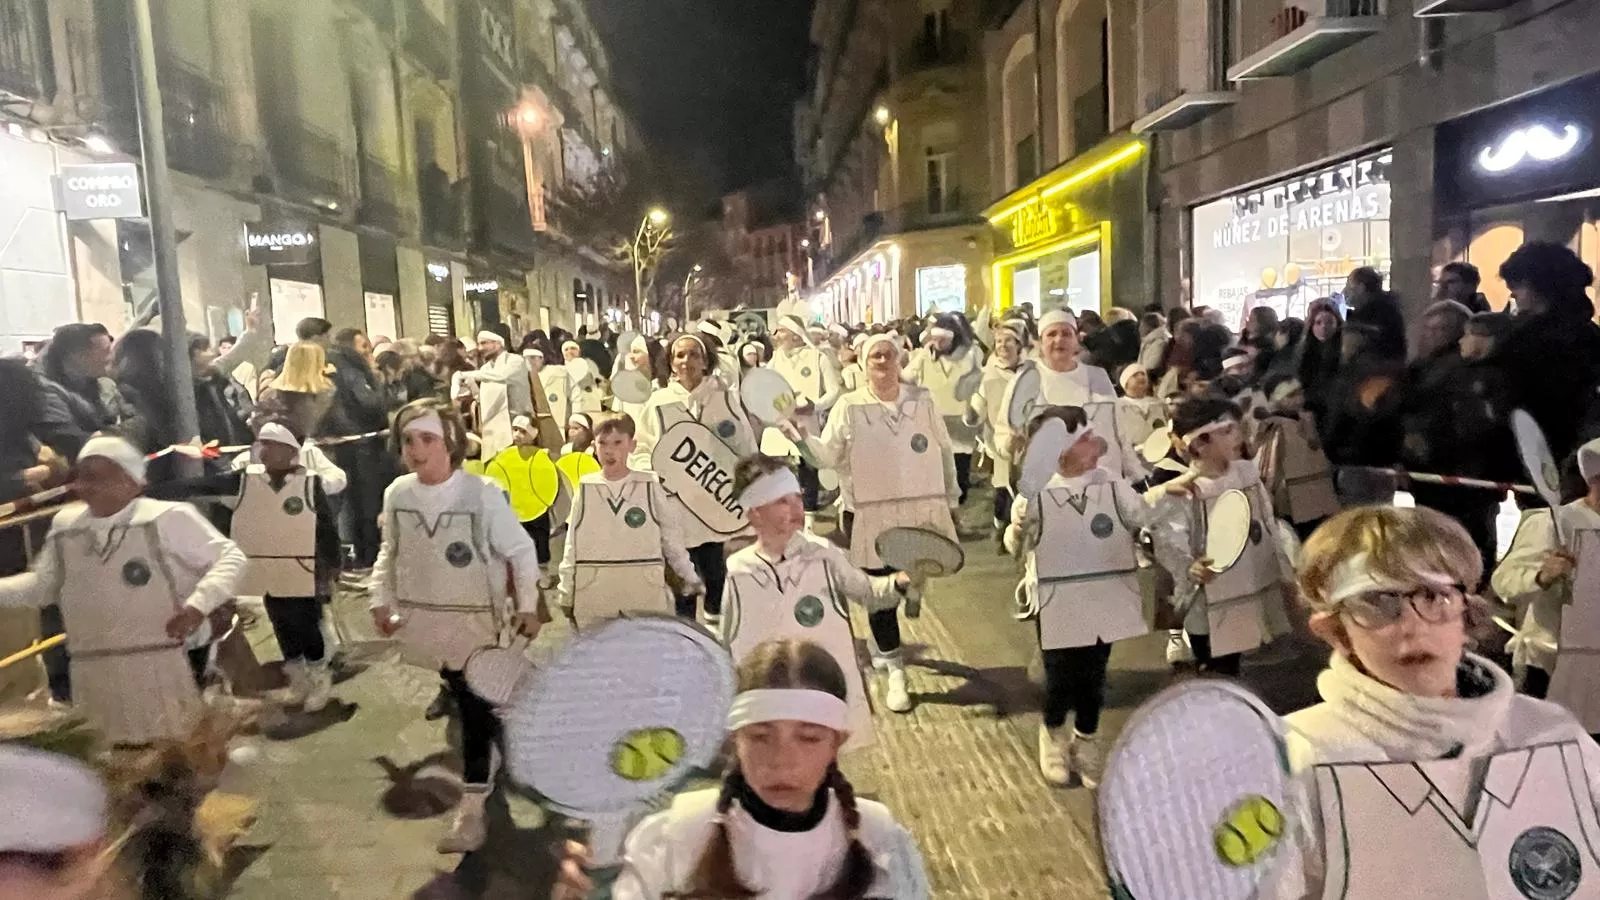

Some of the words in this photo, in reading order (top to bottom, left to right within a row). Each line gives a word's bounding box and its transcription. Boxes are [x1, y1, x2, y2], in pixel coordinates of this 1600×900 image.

[68, 176, 133, 190] COMPRO
[86, 194, 121, 207] ORO
[1267, 214, 1290, 238] DE
[1297, 191, 1379, 231] ARENAS
[249, 233, 307, 246] MANGO
[465, 281, 498, 290] MANGO
[1218, 286, 1249, 300] REBAJAS
